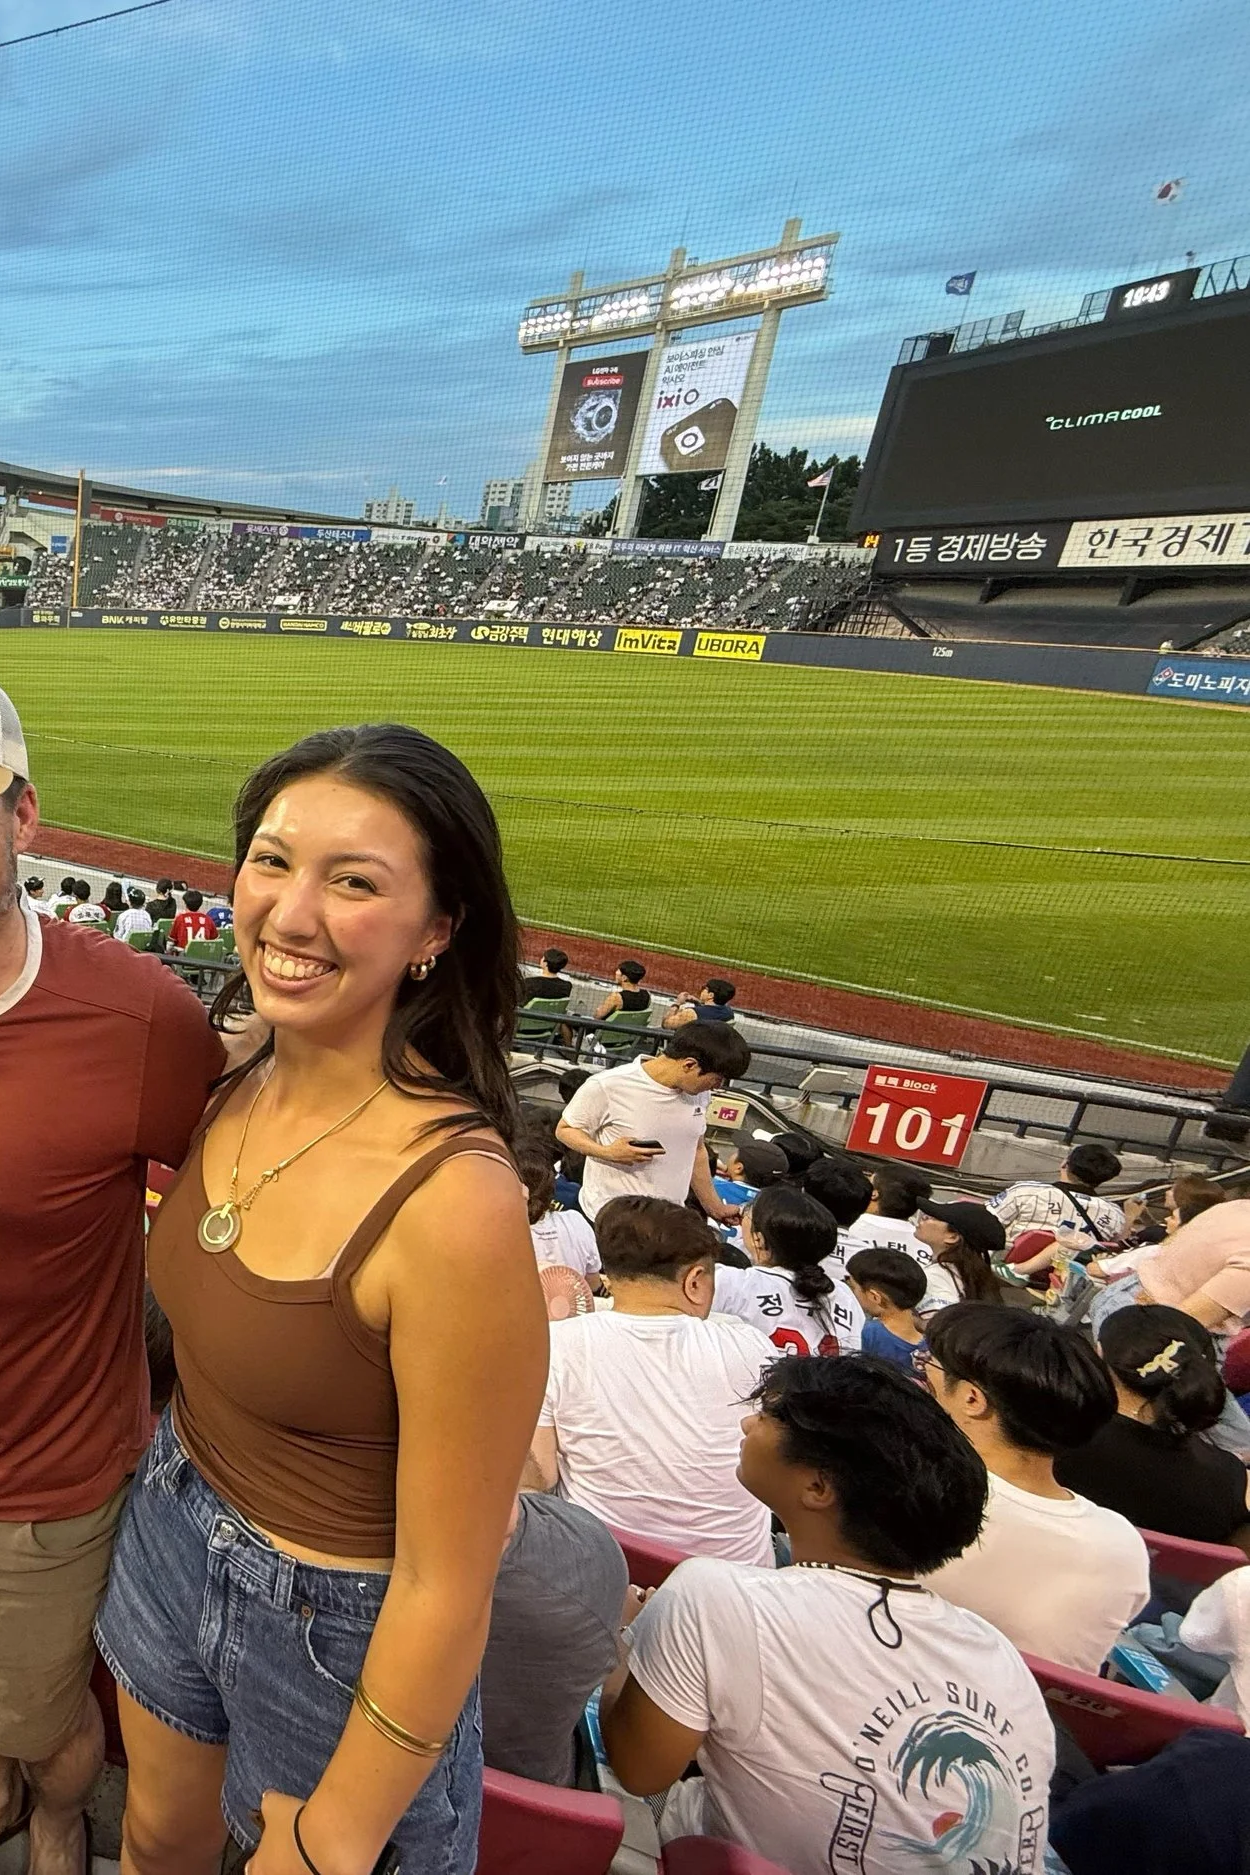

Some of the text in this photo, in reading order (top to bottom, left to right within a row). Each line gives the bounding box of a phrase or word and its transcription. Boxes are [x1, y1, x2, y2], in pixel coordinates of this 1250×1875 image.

[1122, 281, 1170, 308] 19:43
[666, 344, 725, 363] 보이스피싱 안심
[664, 360, 707, 374] AI 에이전트
[662, 373, 686, 386] 익시오
[468, 535, 520, 548] 대화제약
[892, 530, 1048, 563] 1등 경제방송
[490, 625, 529, 643] 금강주택
[541, 627, 602, 648] 현대해상
[697, 636, 761, 655] UBORA
[932, 646, 953, 658] 125m
[1167, 672, 1250, 697] 도미노피자
[902, 1080, 938, 1093] Block
[866, 1102, 966, 1156] 101
[944, 1681, 1014, 1737] SURF
[1014, 1753, 1034, 1802] CO.
[834, 1804, 869, 1867] FIRST
